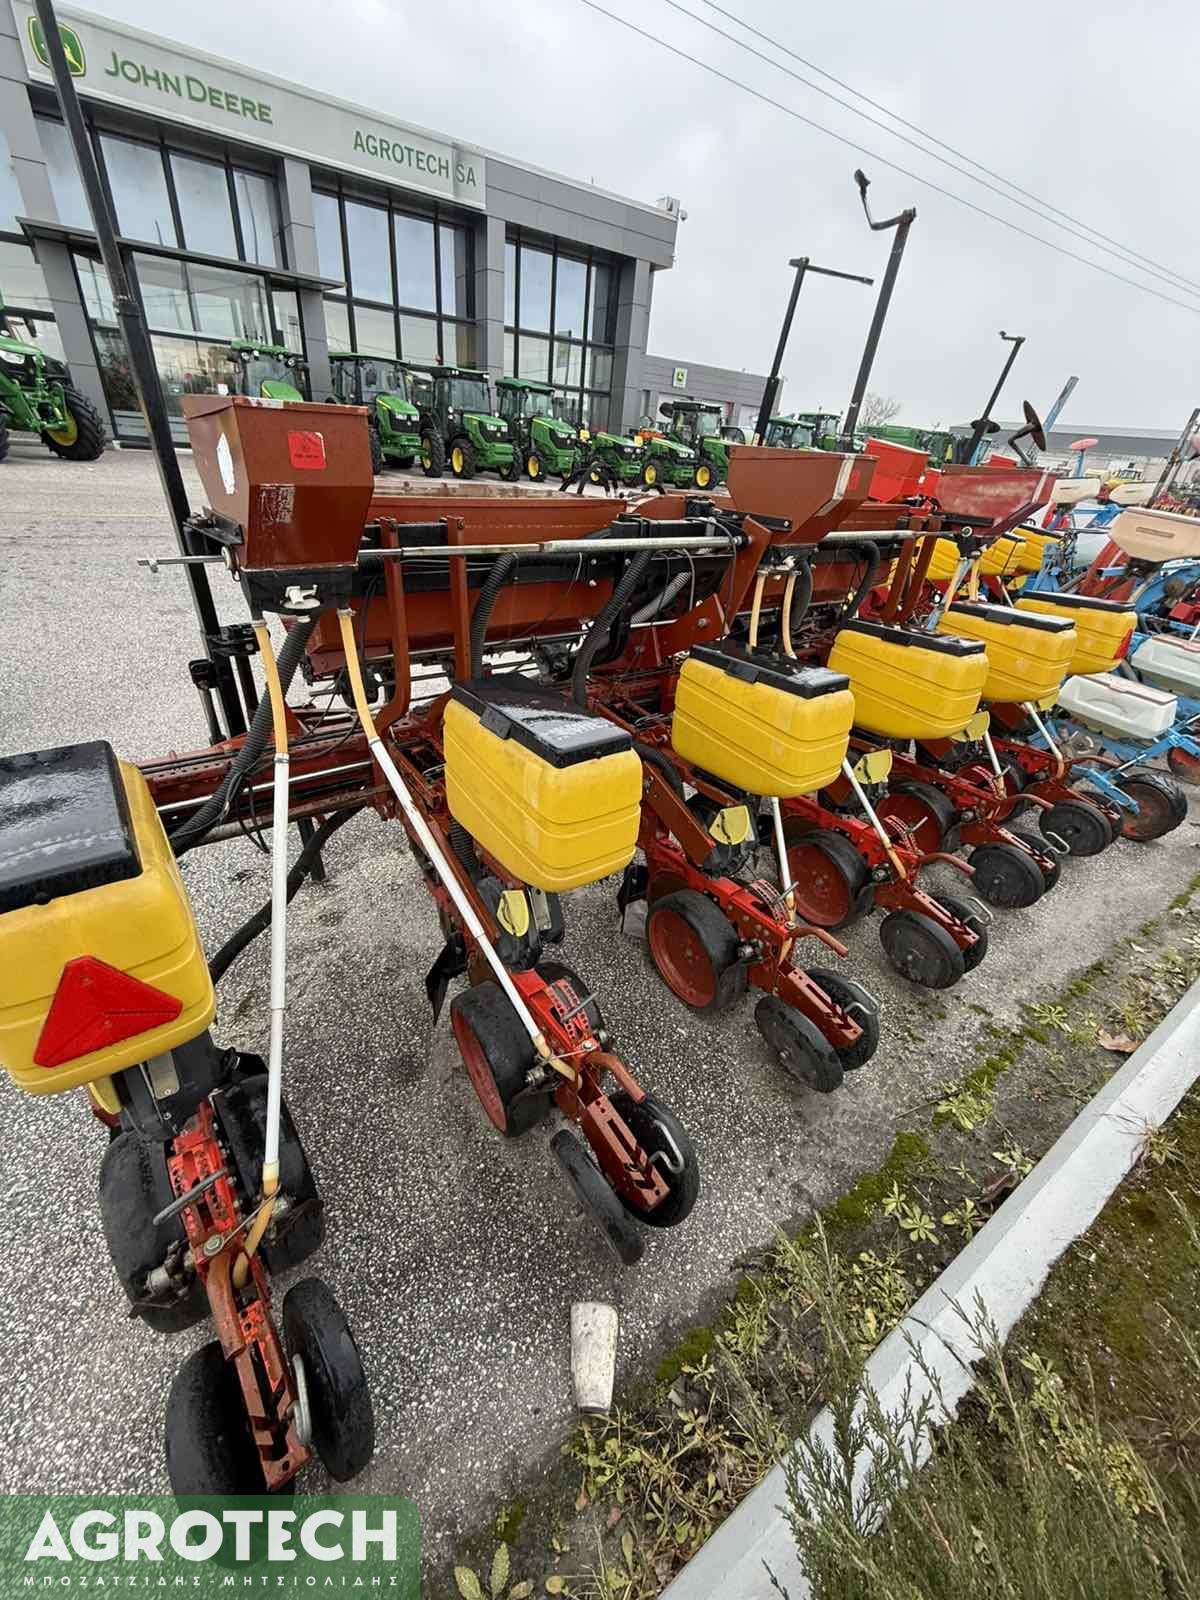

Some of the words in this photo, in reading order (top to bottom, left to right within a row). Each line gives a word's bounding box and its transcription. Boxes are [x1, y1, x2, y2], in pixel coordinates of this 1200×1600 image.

[104, 51, 182, 97] JOHN
[185, 75, 273, 125] DEERE
[353, 130, 449, 179] AGROTECH
[455, 163, 477, 187] SA
